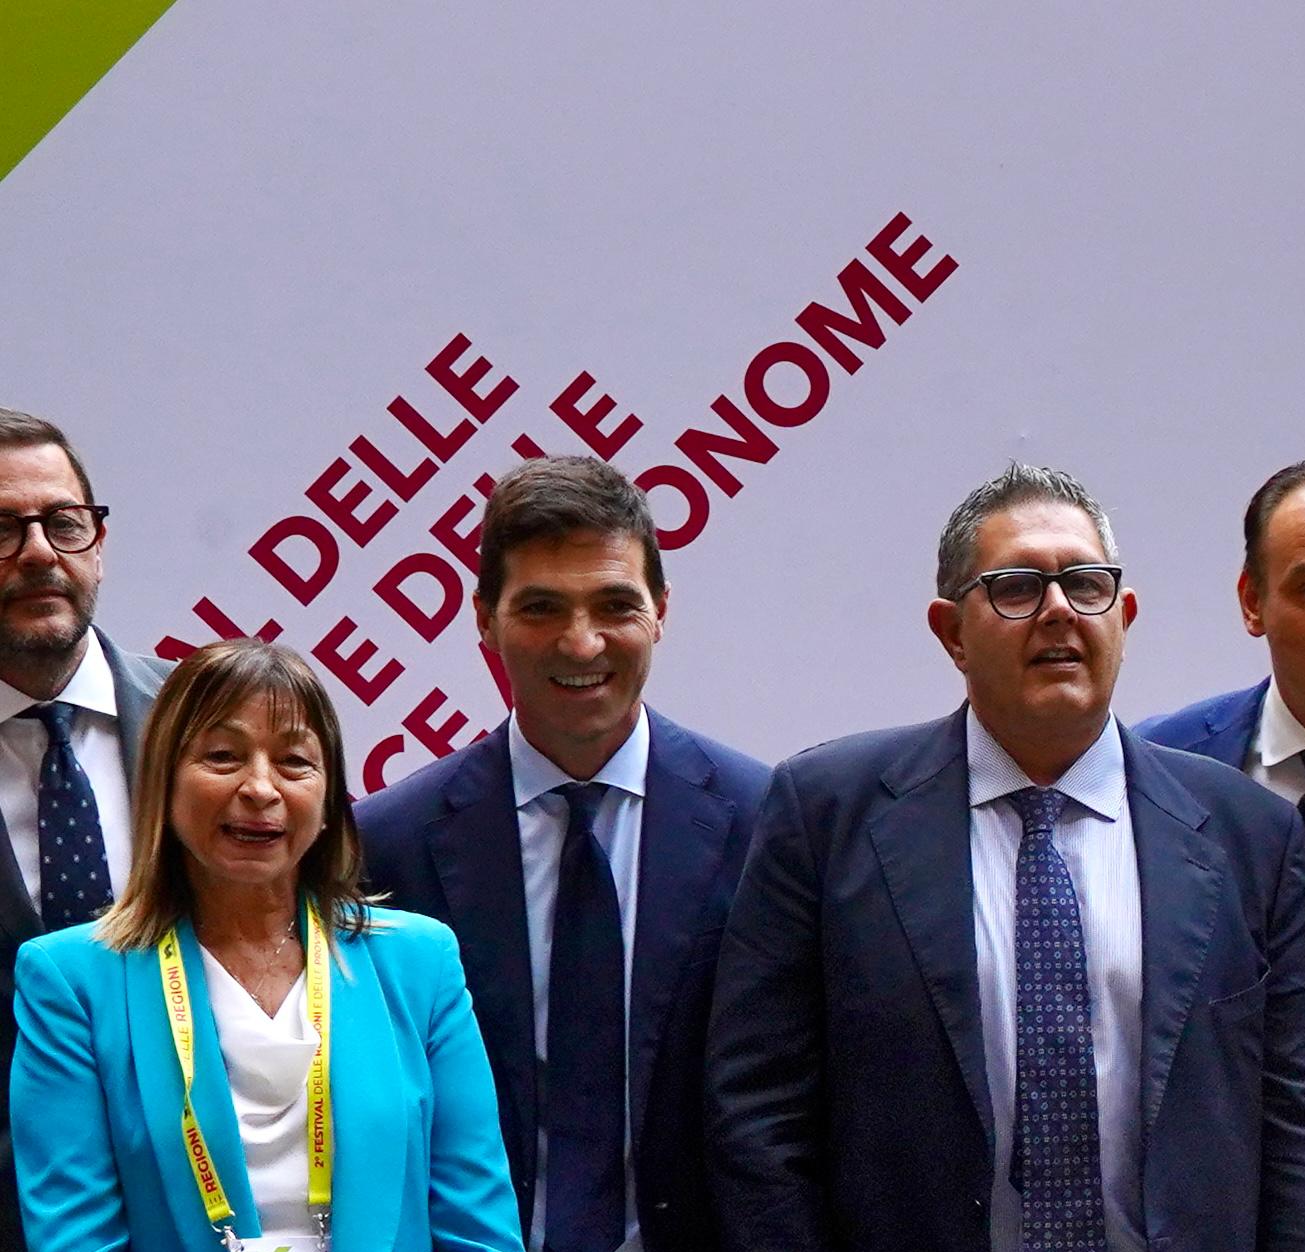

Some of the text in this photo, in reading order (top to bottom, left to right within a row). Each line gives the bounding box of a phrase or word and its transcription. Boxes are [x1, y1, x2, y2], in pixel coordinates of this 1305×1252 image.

[247, 332, 521, 606] DELLE
[311, 370, 645, 707] E DEE
[167, 965, 187, 1023] REGIONI
[314, 1055, 324, 1094] DELLE
[314, 1097, 325, 1153] FESTIVAL
[186, 1127, 217, 1194] REGIONI
